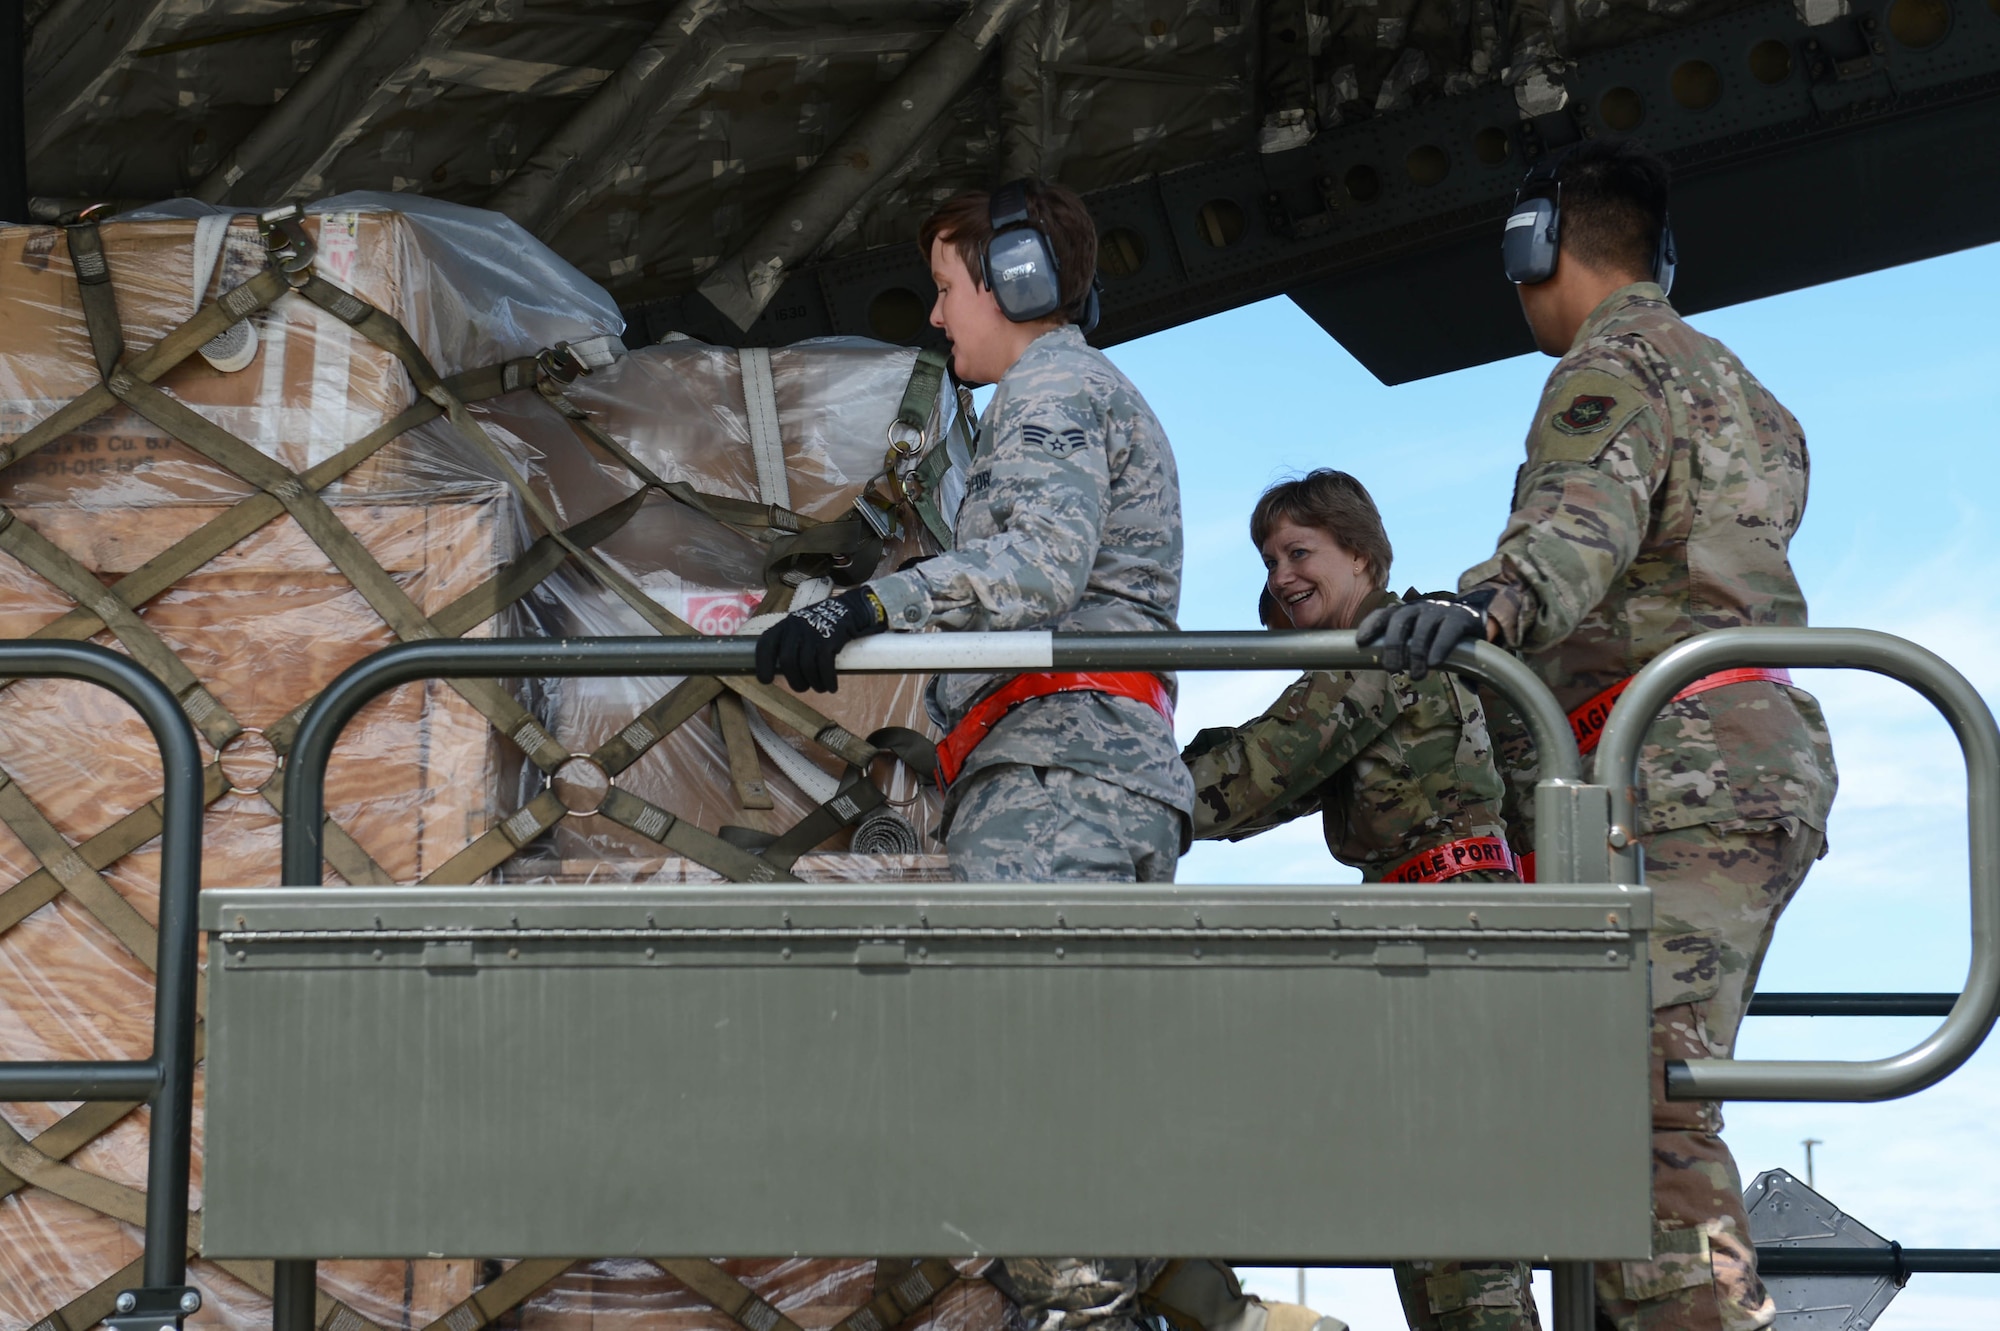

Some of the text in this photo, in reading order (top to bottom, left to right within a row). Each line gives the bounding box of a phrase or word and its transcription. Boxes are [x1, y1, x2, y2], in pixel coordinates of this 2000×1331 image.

[775, 305, 807, 321] 1630
[108, 435, 137, 452] Cu.
[1452, 842, 1501, 865] PORT
